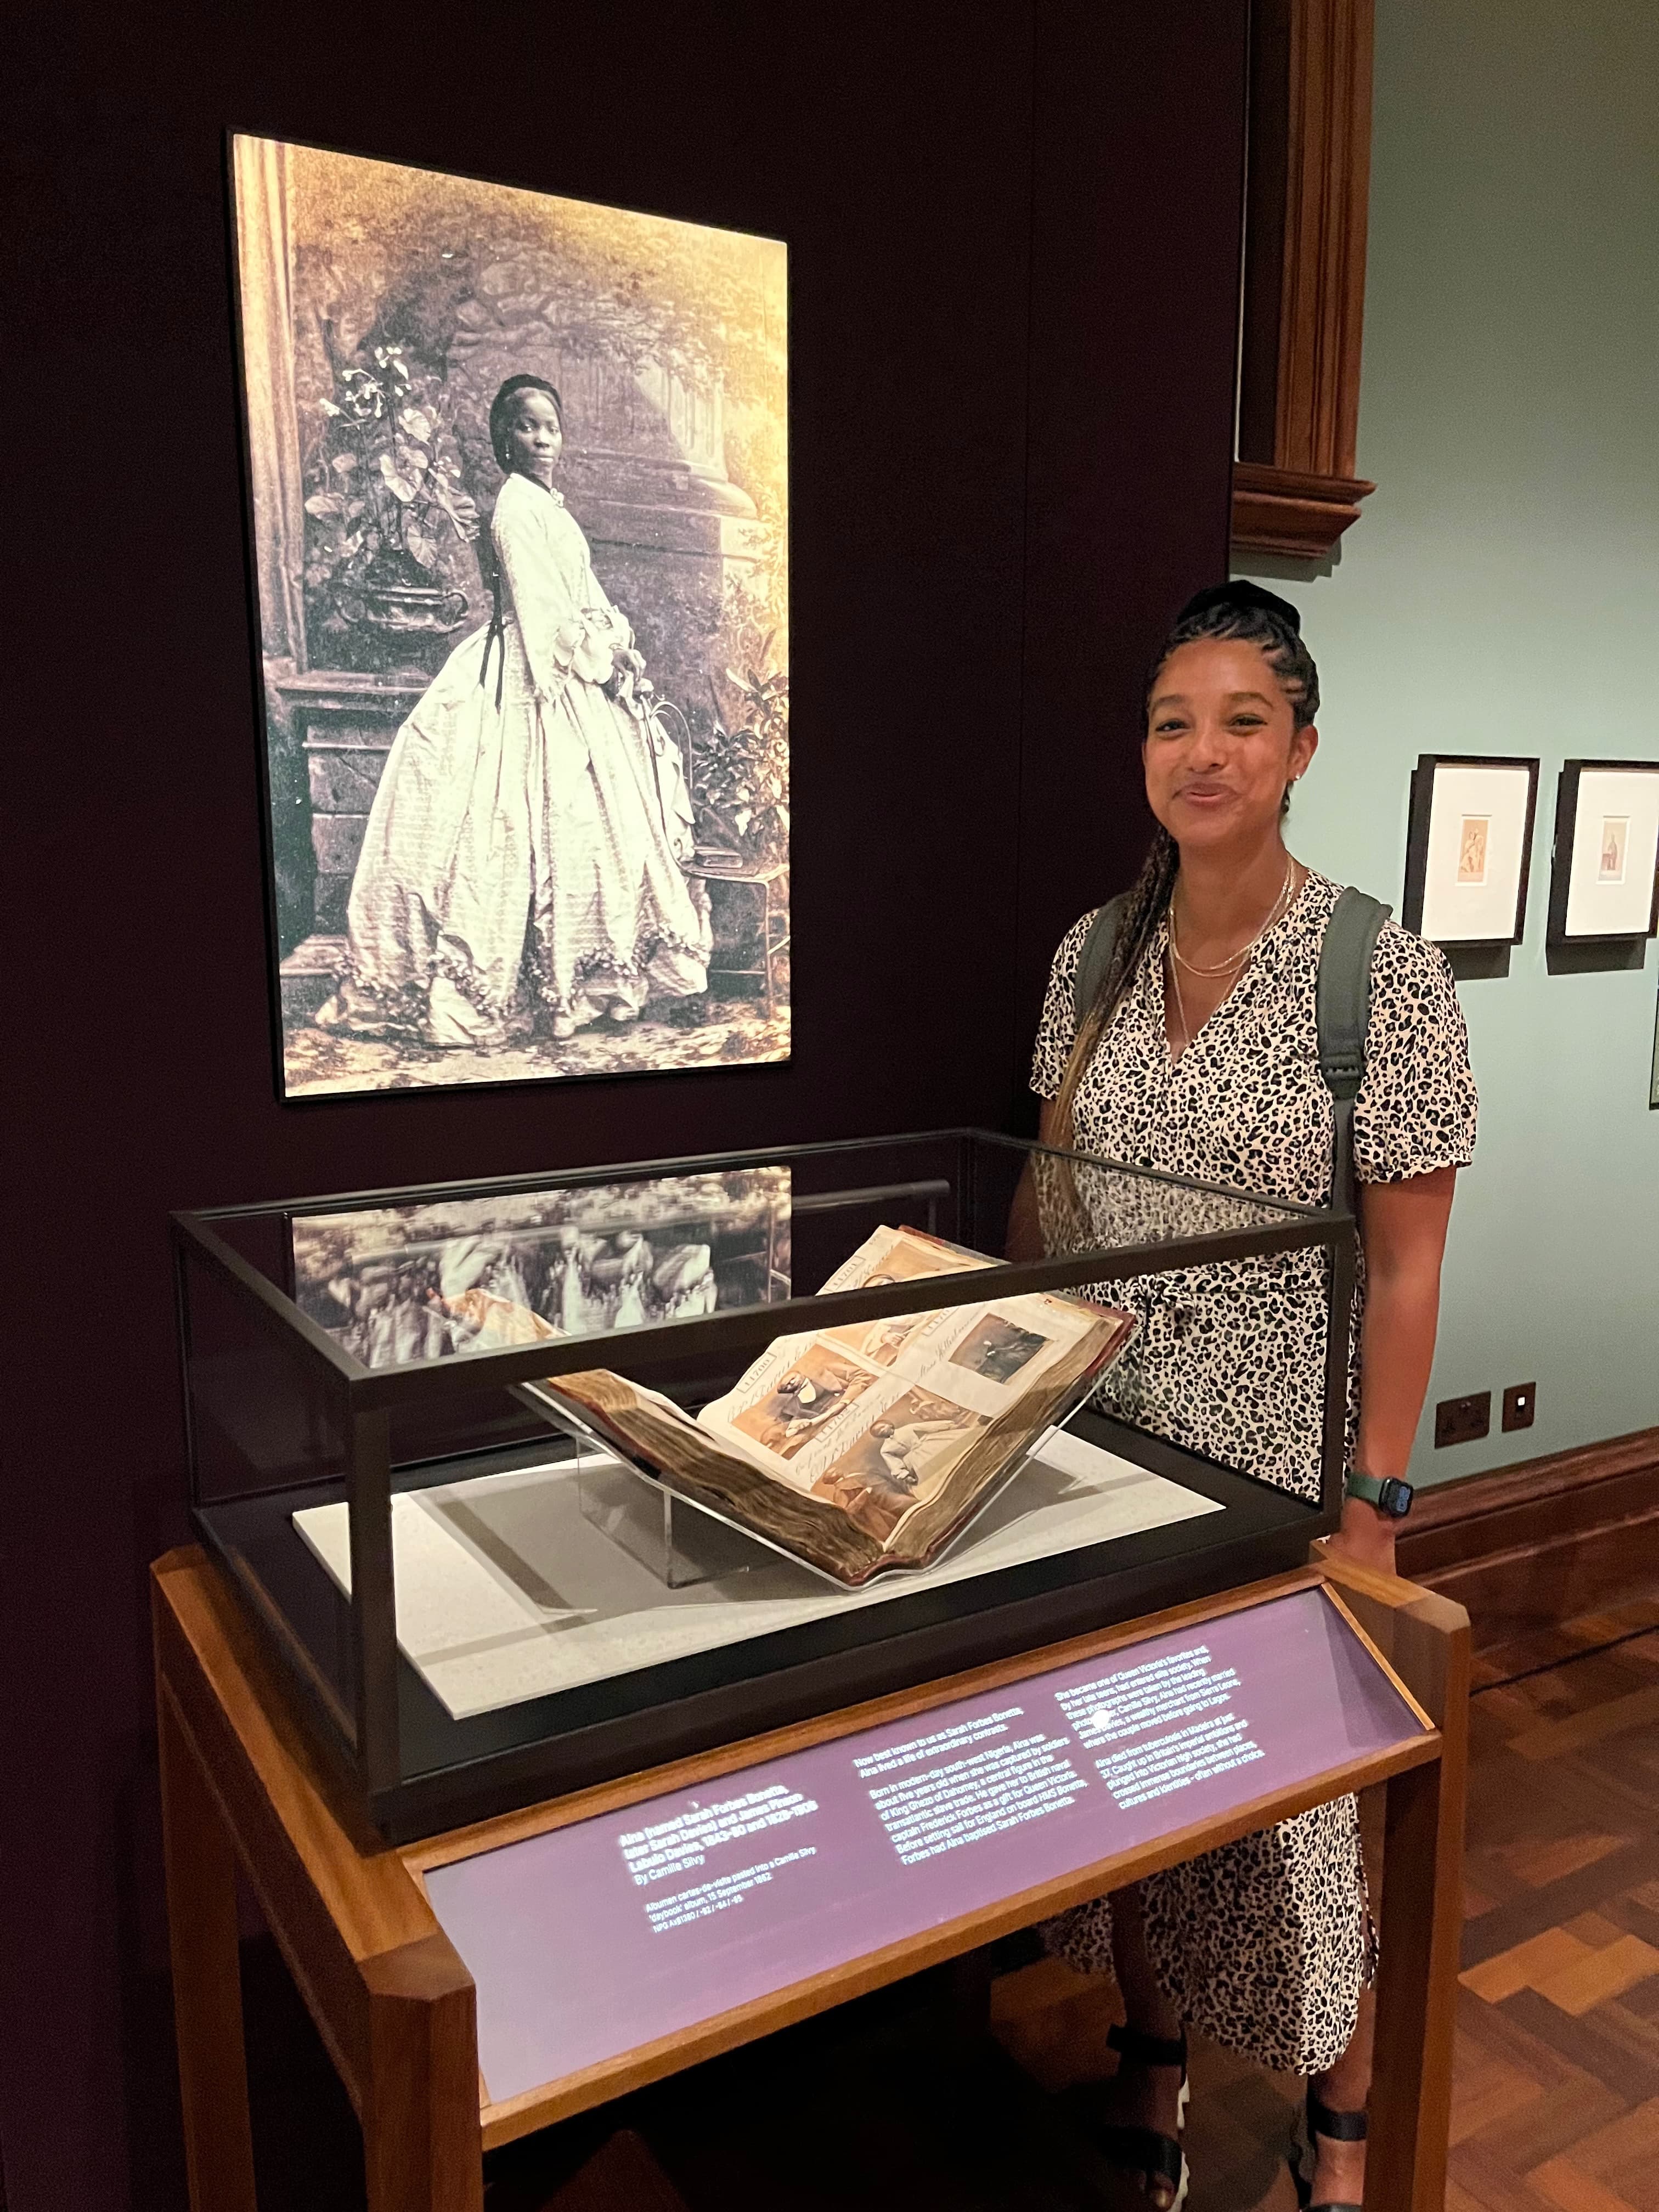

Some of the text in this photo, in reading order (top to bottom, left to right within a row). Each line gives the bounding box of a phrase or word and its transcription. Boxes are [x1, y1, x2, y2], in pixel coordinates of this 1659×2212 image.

[743, 1358, 771, 1386] 11700
[1065, 1668, 1206, 1720] these photographs were taken leading
[1068, 1682, 1098, 1697] became
[1117, 1668, 1140, 1680] Queen
[1081, 1694, 1097, 1703] late
[1130, 1673, 1155, 1688] entered
[1190, 1655, 1211, 1667] When
[1117, 1700, 1143, 1714] Camille
[1159, 1690, 1175, 1700] Aina
[1185, 1677, 1212, 1691] recently
[1130, 1707, 1156, 1721] wealthy
[1154, 1696, 1186, 1712] merchant
[1184, 1691, 1201, 1702] from
[1199, 1685, 1220, 1697] Sierra
[853, 1756, 874, 1768] Now
[872, 1749, 893, 1762] best
[890, 1741, 918, 1756] known
[945, 1724, 969, 1737] Sarah
[967, 1716, 994, 1730] Forbes
[1083, 1736, 1107, 1749] where
[1117, 1724, 1141, 1737] couple
[1139, 1715, 1164, 1729] moved
[1160, 1708, 1184, 1722] before
[1182, 1702, 1204, 1716] going
[1095, 1720, 1215, 1769] Aina died from tuberculosis Madeira
[1111, 1759, 1138, 1775] Caught
[1178, 1734, 1205, 1750] imperial
[1204, 1724, 1235, 1741] ambitions
[860, 1767, 879, 1779] Aina
[877, 1759, 898, 1772] lived
[902, 1753, 917, 1764] life
[925, 1735, 973, 1756] extraordinary
[869, 1787, 890, 1799] Born
[898, 1768, 944, 1790] modern-day
[944, 1753, 986, 1774] south-west
[1013, 1739, 1030, 1750] Aina
[1029, 1734, 1046, 1745] was
[874, 1795, 900, 1810] about
[898, 1791, 915, 1802] five
[913, 1783, 936, 1798] years
[935, 1778, 950, 1789] old
[948, 1771, 970, 1785] when
[969, 1767, 985, 1777] she
[983, 1761, 1001, 1772] was
[999, 1749, 1032, 1767] captured
[1106, 1772, 1136, 1791] plunged
[1133, 1768, 1149, 1779] into
[1176, 1752, 1193, 1763] high
[1113, 1782, 1141, 1799] crossed
[1139, 1772, 1171, 1789] immense
[1169, 1759, 1207, 1778] boundaries
[1204, 1748, 1234, 1764] between
[884, 1809, 934, 1832] transatlantic
[932, 1802, 954, 1815] slave
[974, 1790, 989, 1799] He
[987, 1783, 1007, 1797] gave
[1005, 1778, 1019, 1788] her
[1026, 1767, 1052, 1781] British
[1050, 1759, 1071, 1773] naval
[889, 1805, 910, 1818] King
[907, 1796, 934, 1811] Ghezo
[986, 1768, 1012, 1784] central
[1010, 1762, 1033, 1775] figure
[1039, 1754, 1054, 1764] the
[1119, 1793, 1148, 1809] cultures
[1158, 1776, 1192, 1794] identities
[1194, 1768, 1213, 1781] often
[1211, 1759, 1238, 1774] without
[619, 1831, 646, 1847] Aina
[682, 1808, 714, 1826] Sarah
[711, 1798, 749, 1816] Forbes
[648, 1833, 681, 1852] Sarah
[717, 1813, 739, 1828] and
[738, 1804, 771, 1821] James
[767, 1793, 803, 1810] Pinson
[746, 1817, 768, 1833] and
[891, 1826, 921, 1843] captain
[919, 1813, 957, 1832] Frederick
[955, 1804, 984, 1819] Forbes
[998, 1792, 1014, 1805] gift
[1011, 1788, 1024, 1799] for
[1023, 1780, 1048, 1795] Queen
[895, 1838, 924, 1854] Before
[923, 1829, 952, 1844] setting
[950, 1821, 965, 1834] sail
[963, 1819, 976, 1829] for
[975, 1807, 1007, 1825] England
[1015, 1795, 1040, 1810] board
[1037, 1787, 1058, 1802] HMS
[901, 1849, 931, 1865] Forbes
[929, 1842, 947, 1855] had
[946, 1836, 965, 1849] Aina
[962, 1823, 997, 1842] baptised
[996, 1816, 1019, 1830] Sarah
[1017, 1807, 1045, 1822] Forbes
[633, 1854, 705, 1886] By Camille Silvy
[646, 1895, 678, 1913] Albumen
[731, 1866, 756, 1883] pasted
[754, 1863, 769, 1873] into
[774, 1852, 800, 1866] Camille
[798, 1847, 816, 1858] Silvy
[707, 1891, 717, 1901] 15
[716, 1879, 754, 1898] September
[753, 1872, 772, 1884] 1862
[653, 1921, 669, 1933] NPG
